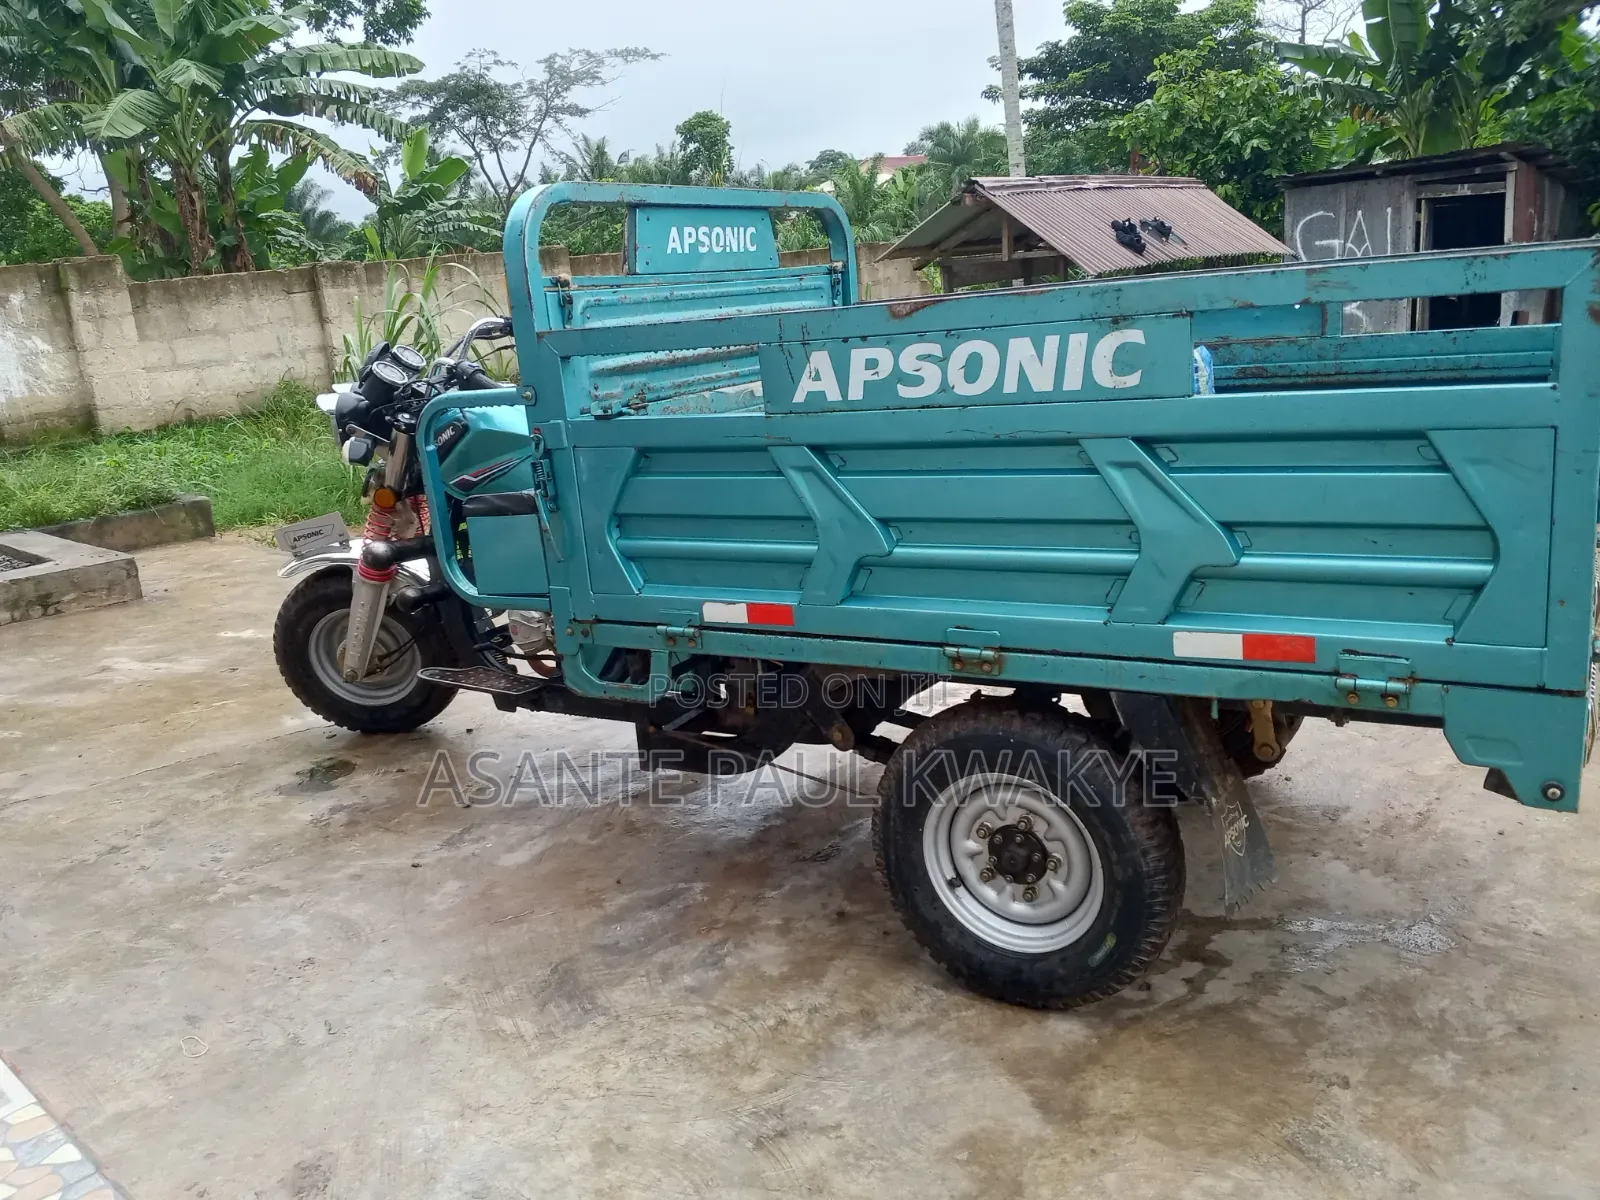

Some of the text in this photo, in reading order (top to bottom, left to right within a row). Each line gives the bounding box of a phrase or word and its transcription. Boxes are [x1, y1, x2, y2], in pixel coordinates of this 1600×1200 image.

[666, 226, 757, 254] APSONIC
[792, 329, 1146, 403] APSONIC
[292, 529, 324, 543] APSONIC
